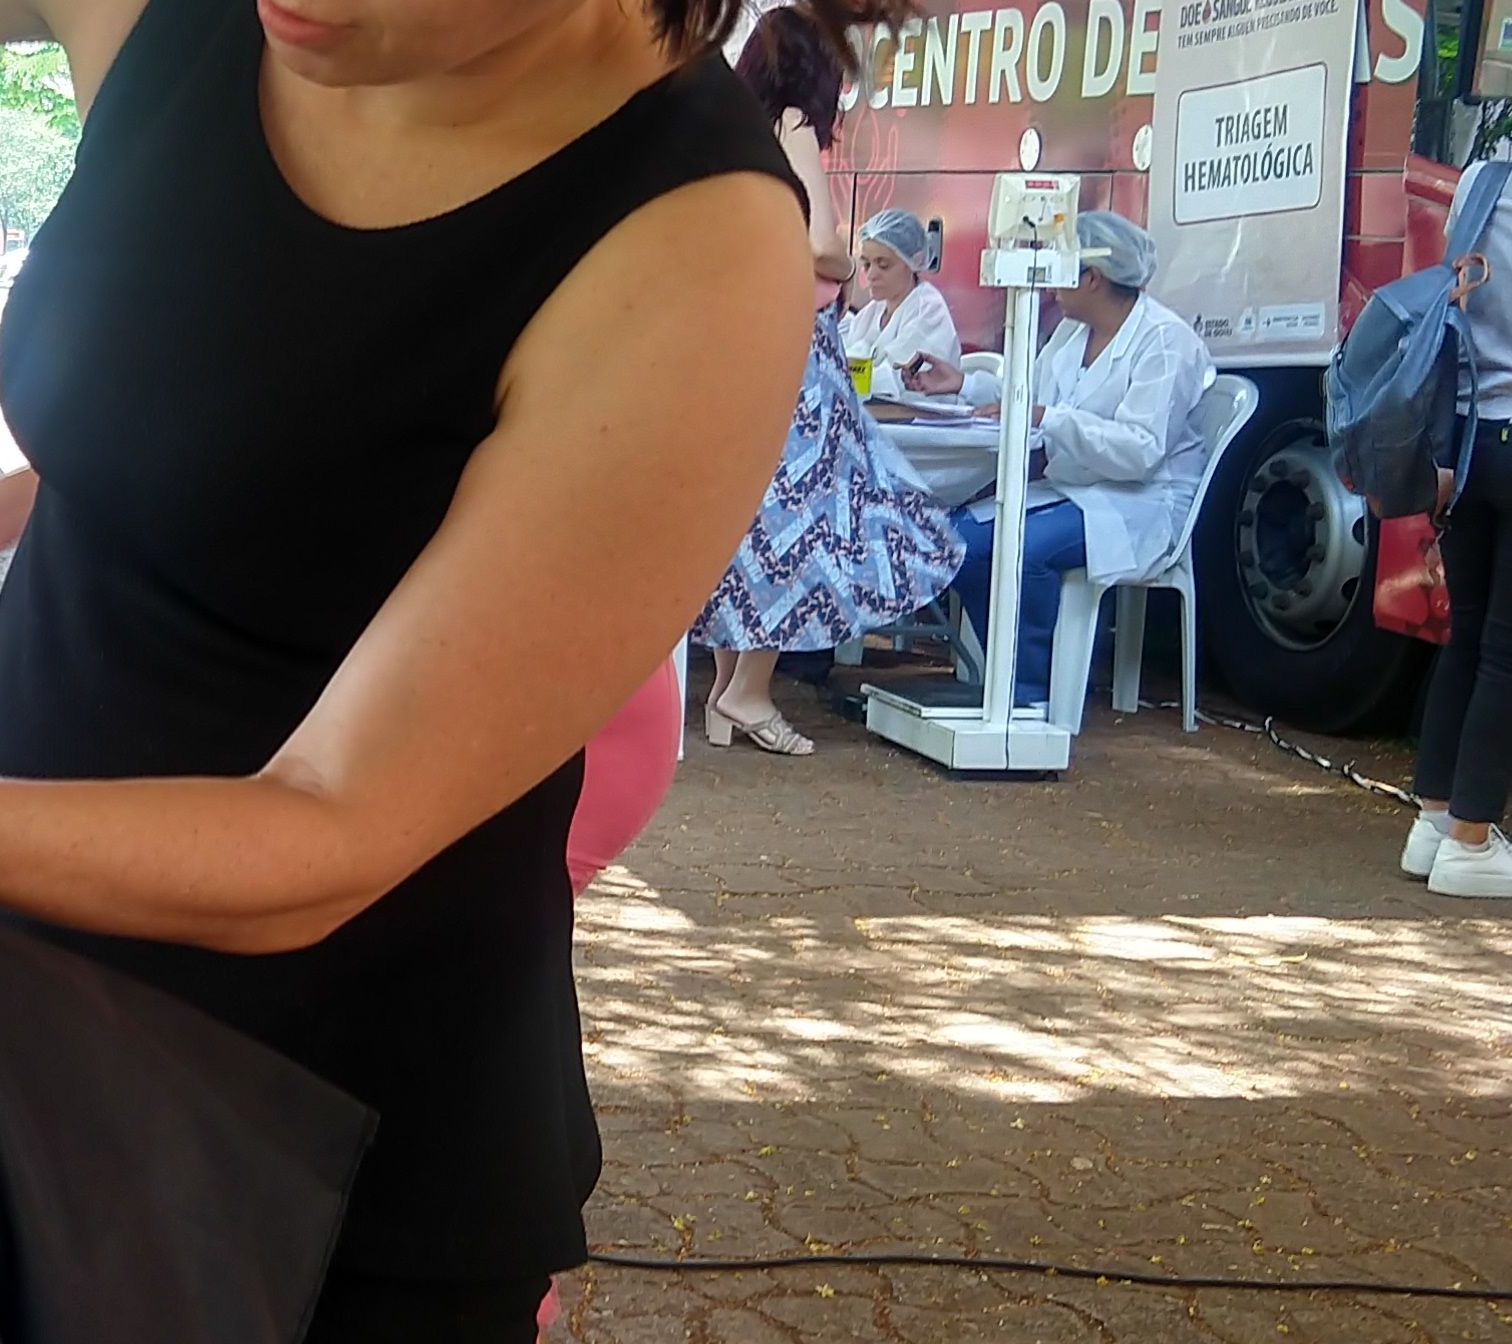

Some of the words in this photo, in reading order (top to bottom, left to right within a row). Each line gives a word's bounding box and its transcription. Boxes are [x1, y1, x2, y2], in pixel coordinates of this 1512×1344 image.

[1178, 36, 1193, 49] TEM
[1194, 27, 1225, 46] SEMPRE
[1301, 4, 1312, 20] DE
[1180, 2, 1203, 28] DOE
[1216, 104, 1287, 148] TRIAGEM
[1184, 143, 1313, 193] HEMATOLÓGICA
